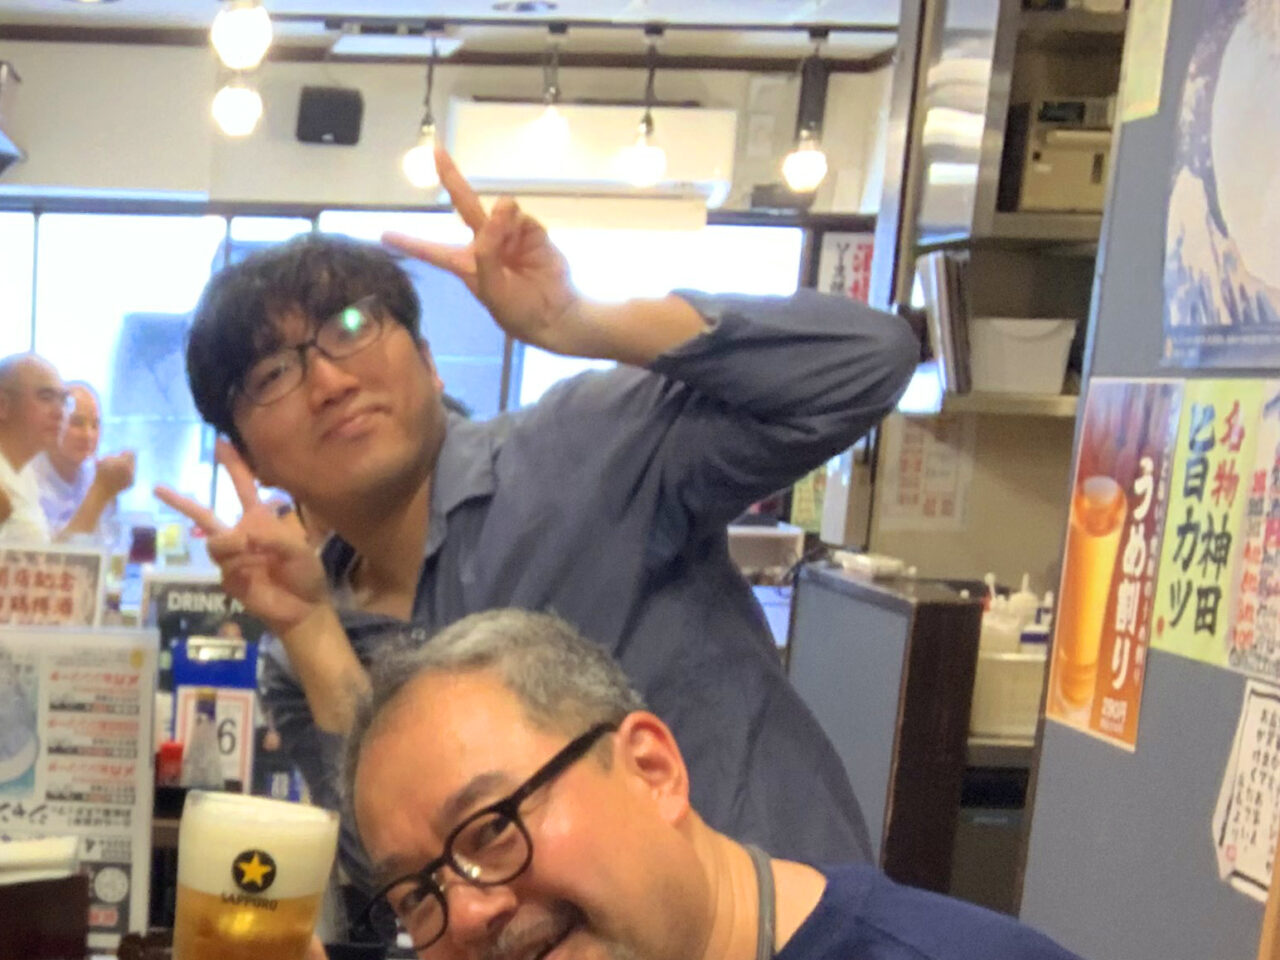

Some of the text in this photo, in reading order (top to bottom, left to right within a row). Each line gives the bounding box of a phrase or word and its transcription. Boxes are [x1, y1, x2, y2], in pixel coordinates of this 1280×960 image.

[1196, 399, 1246, 637] 名物神田
[1111, 456, 1154, 690] うめ割り
[167, 591, 226, 613] DRINK
[216, 716, 237, 755] 6
[221, 890, 279, 912] SAPPORO
